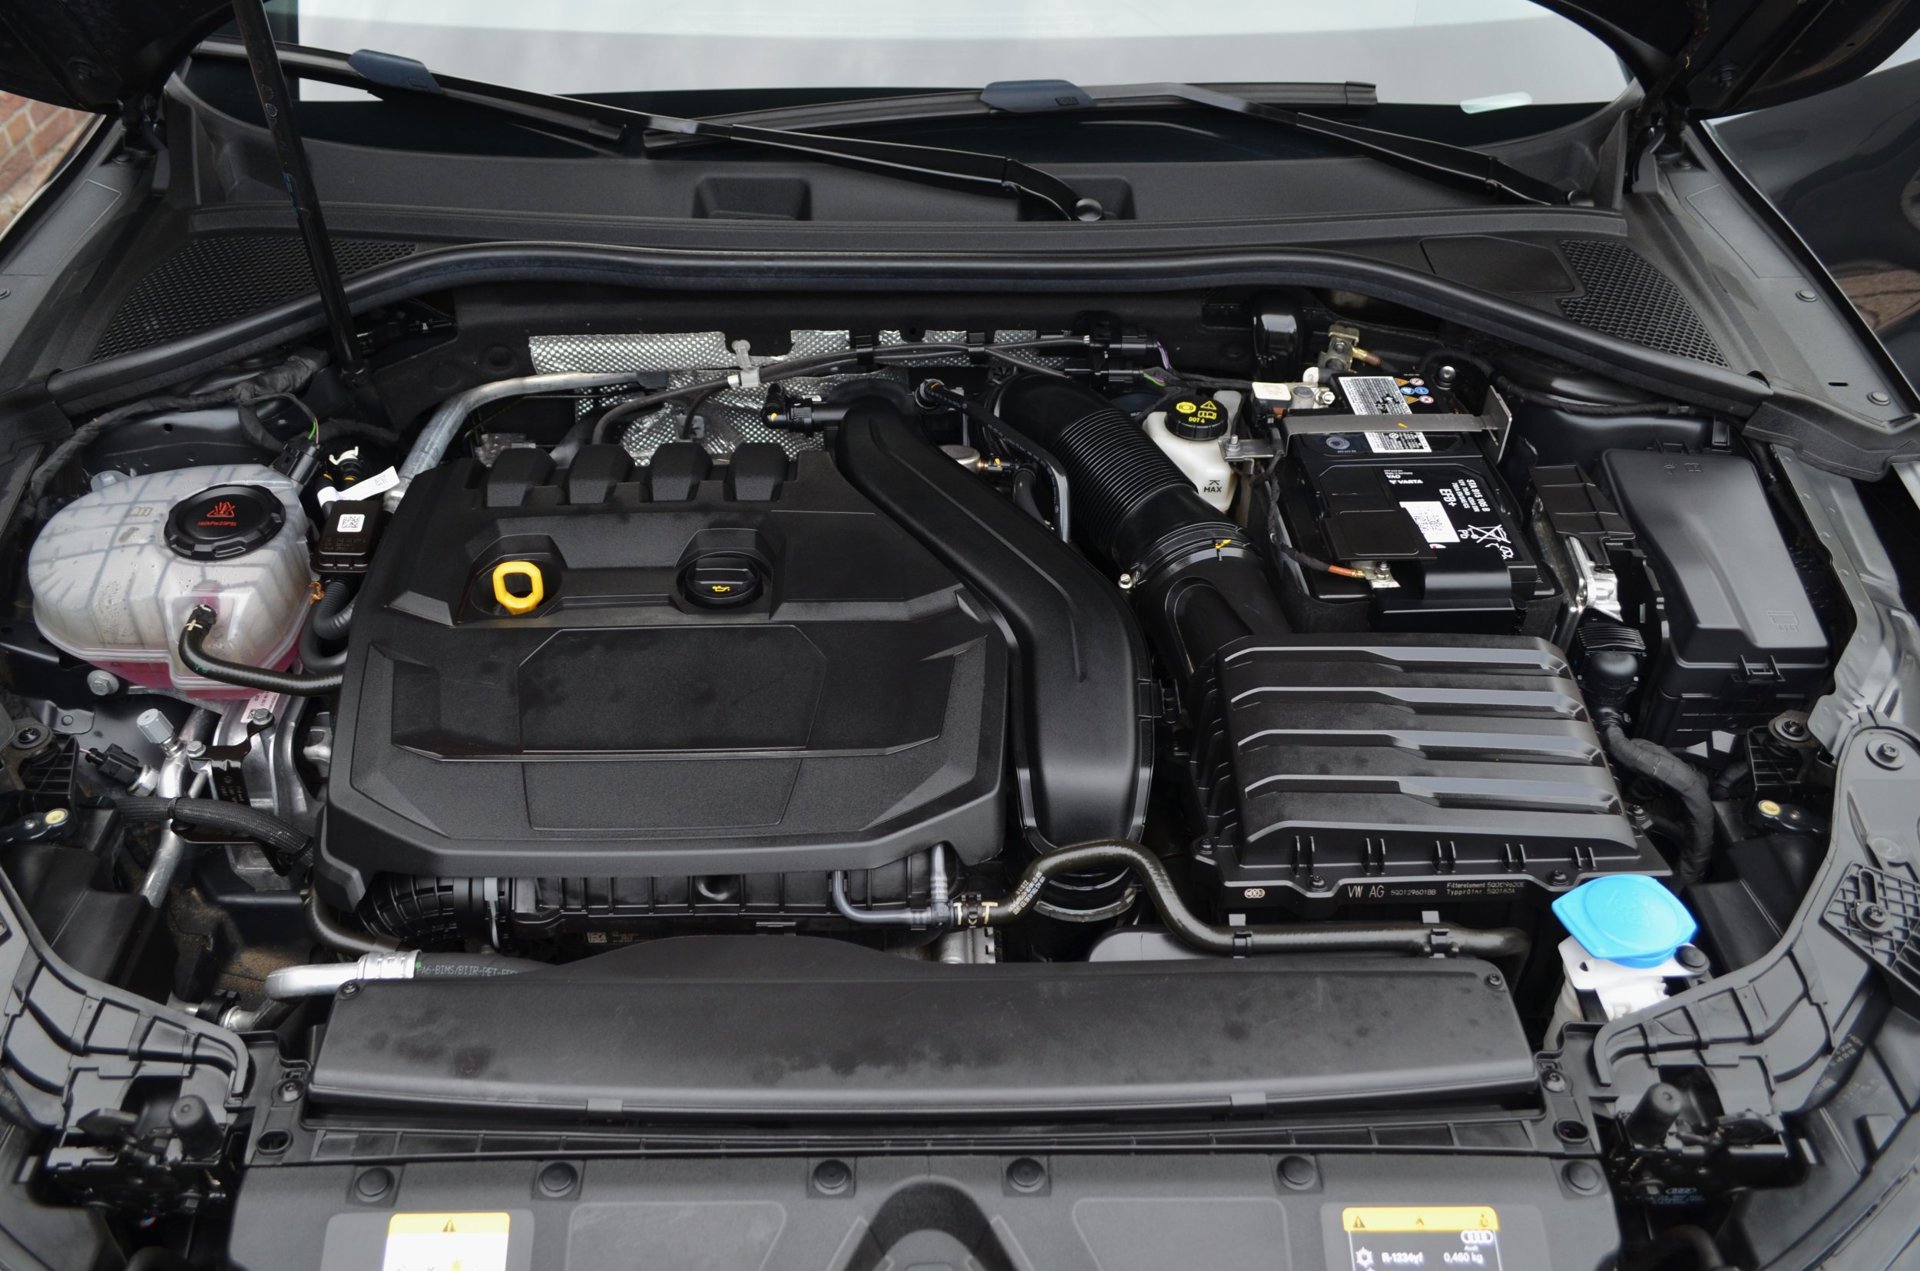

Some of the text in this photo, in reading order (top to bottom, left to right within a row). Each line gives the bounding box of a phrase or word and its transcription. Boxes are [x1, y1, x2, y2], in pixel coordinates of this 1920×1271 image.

[1439, 489, 1456, 506] EFB+
[1458, 529, 1470, 539] Pb
[1348, 885, 1364, 898] VW
[1368, 884, 1385, 898] AG
[1471, 1252, 1484, 1265] kg
